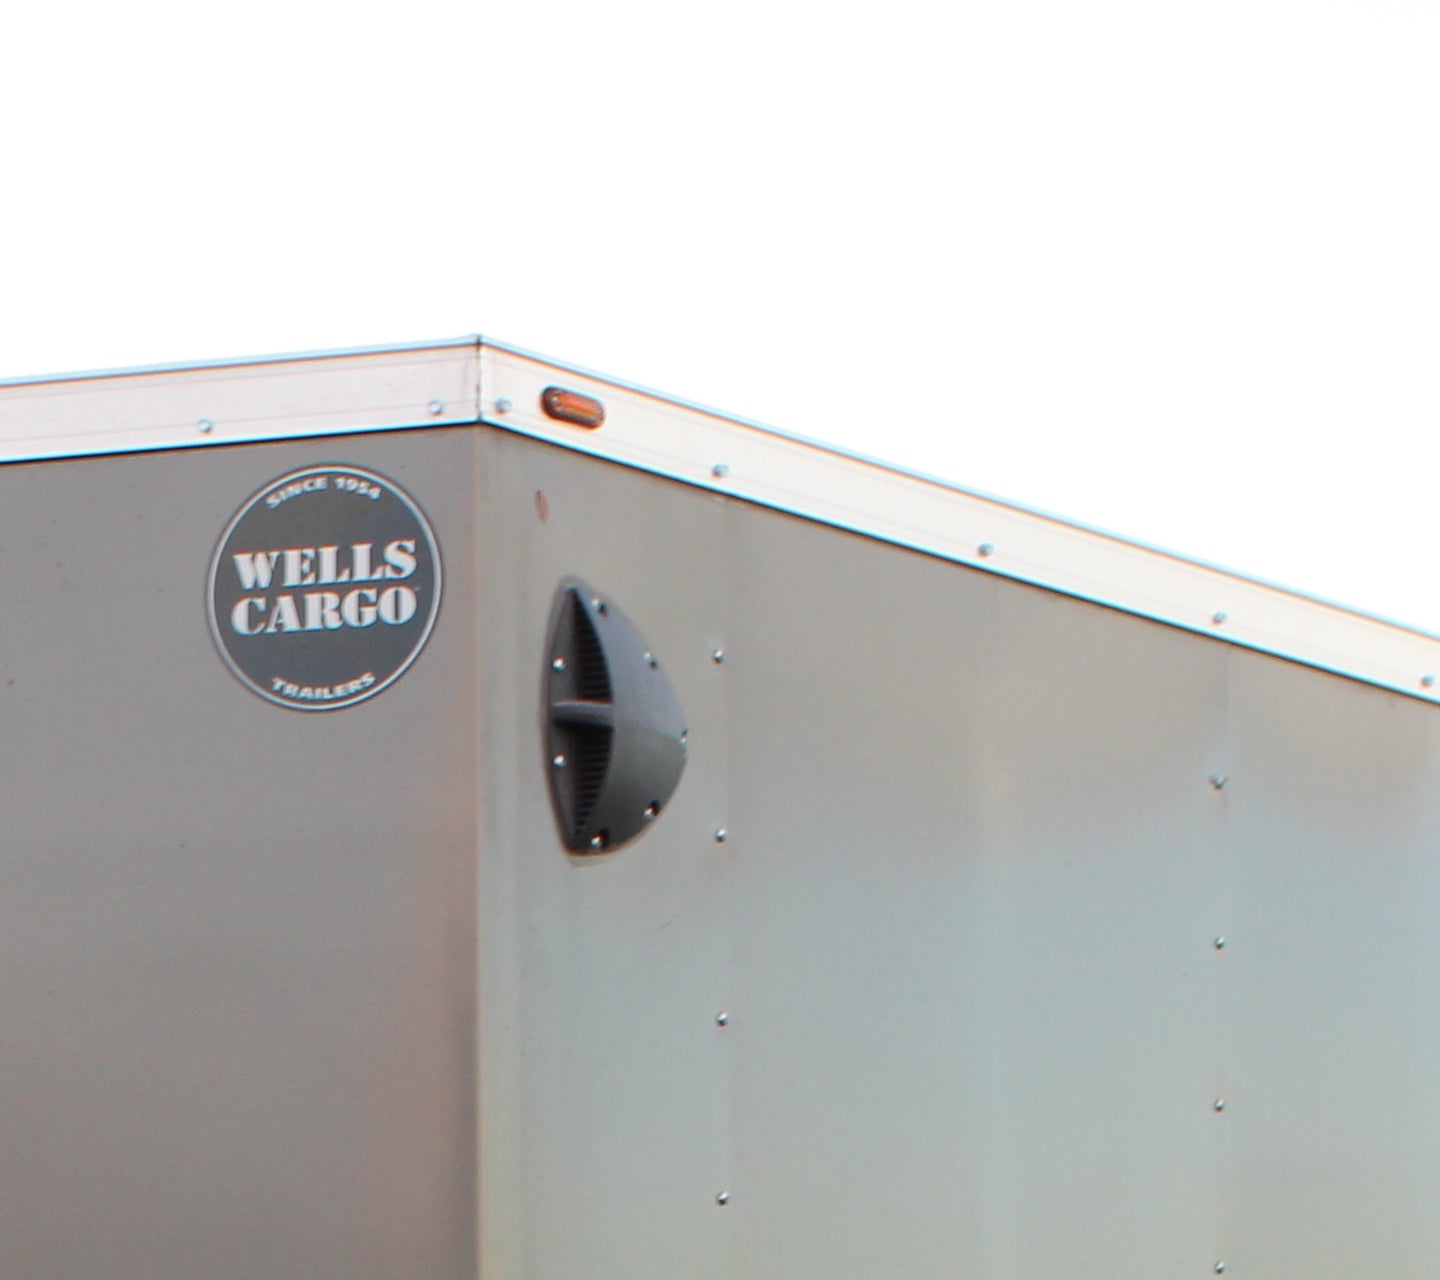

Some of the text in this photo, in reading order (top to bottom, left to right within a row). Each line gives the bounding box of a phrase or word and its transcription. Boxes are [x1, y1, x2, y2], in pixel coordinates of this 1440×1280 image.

[266, 477, 328, 509] SINCE
[232, 538, 417, 590] WELLS
[231, 585, 417, 635] CARGO
[271, 672, 376, 700] TRAILERS
